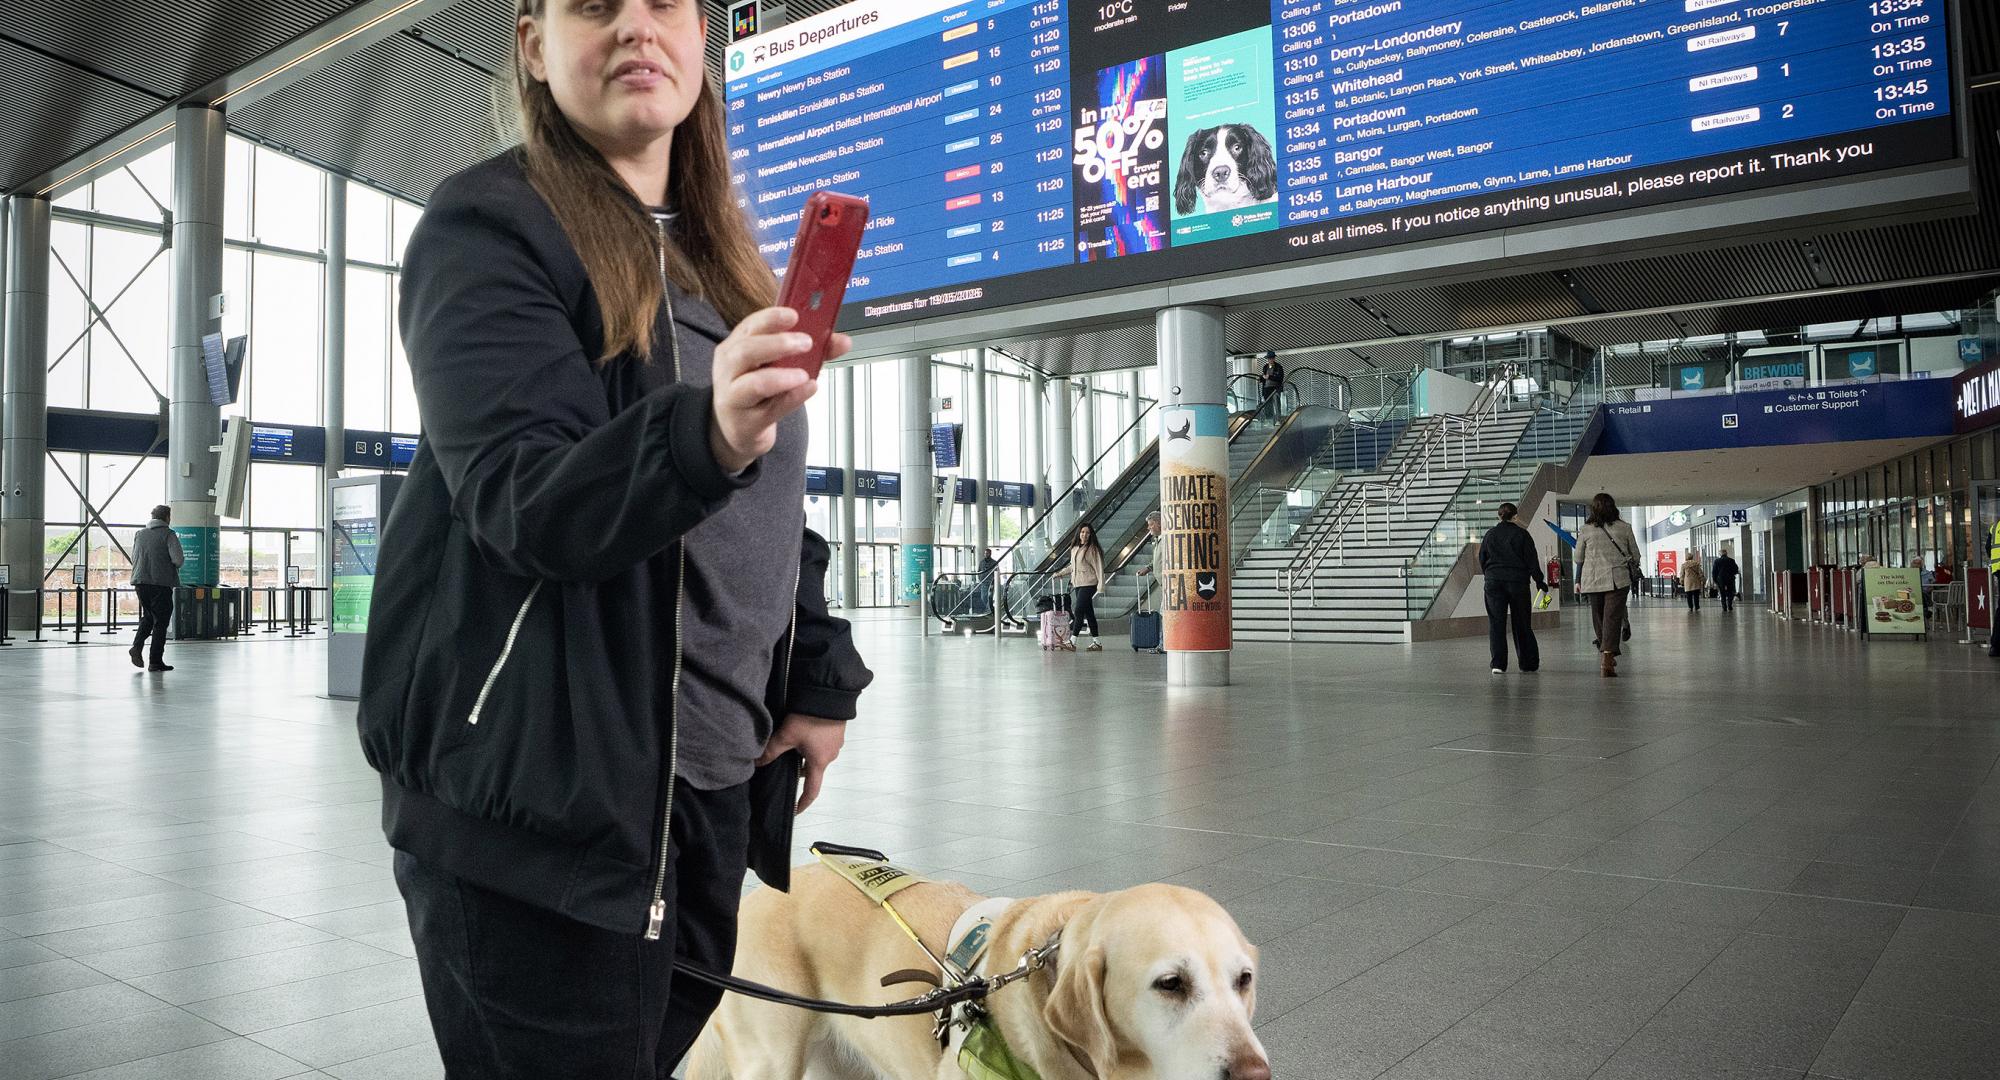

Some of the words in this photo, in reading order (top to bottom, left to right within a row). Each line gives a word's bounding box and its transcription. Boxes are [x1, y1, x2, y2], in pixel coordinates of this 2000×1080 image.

[943, 10, 968, 24] Operator
[1032, 1, 1059, 17] 11:15
[1098, 0, 1133, 21] 10°C
[1168, 2, 1188, 13] Friday
[1282, 6, 1311, 20] Calling
[1312, 4, 1322, 13] at
[1282, 22, 1316, 39] 13:06
[1330, 1, 1401, 27] Portadown
[1777, 22, 1790, 37] 7
[1869, 0, 1923, 17] 13:34
[769, 39, 795, 57] Bus
[799, 10, 880, 46] Departures
[1032, 29, 1060, 45] 11:20
[1094, 18, 1125, 33] moderate
[1124, 14, 1138, 25] rain
[1871, 22, 1892, 34] On
[1894, 14, 1930, 29] Time
[1284, 55, 1318, 72] 13:10
[1331, 22, 1462, 61] Derry~Londonderry
[1346, 53, 1404, 72] Cullybackey,
[1407, 38, 1464, 58] Ballymoney,
[1466, 26, 1517, 44] Coleraine,
[1520, 10, 1579, 31] Castlerock,
[731, 99, 745, 111] 238
[758, 89, 782, 103] Newry
[782, 82, 806, 98] Newry
[807, 76, 823, 88] Bus
[823, 66, 851, 83] Station
[988, 20, 995, 31] 5
[1033, 58, 1061, 75] 11:20
[1351, 91, 1388, 106] Botanic,
[1391, 83, 1425, 98] Lanyon
[1427, 76, 1457, 89] Place,
[1459, 70, 1482, 82] York
[1485, 62, 1518, 76] Street,
[1520, 48, 1586, 68] Whiteabbey,
[1588, 30, 1664, 54] Jordanstown,
[1667, 12, 1742, 36] Greenisland,
[1699, 80, 1709, 88] NI
[1710, 72, 1749, 85] Railways
[1780, 63, 1790, 77] 1
[1871, 36, 1926, 59] 13:35
[1873, 65, 1894, 76] On
[1897, 58, 1933, 72] Time
[732, 124, 745, 136] 261
[758, 109, 799, 128] Enniskillen
[800, 98, 839, 115] Enniskillen
[840, 91, 855, 104] Bus
[856, 82, 885, 98] Station
[988, 47, 1001, 59] 15
[1034, 88, 1062, 104] 11:20
[1286, 88, 1319, 106] 13:15
[1332, 70, 1403, 96] Whitehead
[732, 148, 750, 161] 300a
[758, 132, 806, 153] International
[806, 122, 835, 142] Airport
[836, 114, 863, 131] Belfast
[863, 102, 913, 122] International
[914, 92, 943, 109] Airport
[989, 76, 1002, 87] 10
[1082, 108, 1097, 125] in
[1100, 101, 1129, 122] my
[1701, 120, 1711, 128] NI
[1713, 112, 1751, 126] Railways
[1782, 104, 1794, 119] 2
[1874, 79, 1929, 101] 13:45
[1035, 118, 1062, 134] 11:20
[1286, 122, 1320, 140] 13:34
[1334, 106, 1406, 130] Portadown
[1357, 127, 1386, 139] Moira,
[1388, 119, 1423, 134] Lurgan,
[1426, 106, 1479, 125] Portadown
[758, 160, 798, 179] Newcastle
[798, 148, 838, 167] Newcastle
[838, 142, 855, 156] Bus
[855, 136, 884, 152] Station
[990, 104, 1002, 117] 24
[1074, 113, 1164, 165] 50%
[758, 188, 788, 204] Lisburn
[788, 180, 815, 196] Lisburn
[816, 176, 831, 189] Bus
[832, 169, 860, 186] Station
[990, 132, 1003, 145] 25
[1036, 148, 1063, 163] 11:20
[1082, 149, 1138, 184] OFF
[1288, 156, 1322, 173] 13:35
[1334, 146, 1384, 165] Bangor
[1345, 162, 1388, 176] Carnalea,
[1390, 154, 1425, 168] Bangor
[1426, 148, 1455, 160] West,
[1457, 140, 1494, 155] Bangor
[1036, 178, 1064, 193] 11:20
[1128, 172, 1160, 190] era
[1288, 190, 1323, 207] 13:45
[1336, 182, 1374, 199] Larne
[1377, 171, 1434, 191] Harbour
[1312, 230, 1325, 243] at
[1328, 226, 1344, 242] all
[1346, 220, 1388, 238] times.
[1392, 218, 1401, 231] If
[1404, 214, 1431, 232] you
[1436, 206, 1480, 224] notice
[1484, 193, 1550, 217] anything
[1554, 181, 1623, 205] unusual,
[1628, 171, 1684, 197] please
[1690, 162, 1744, 184] report
[1749, 159, 1766, 174] it.
[1770, 148, 1832, 170] Thank
[1836, 142, 1873, 164] you
[1356, 194, 1403, 210] Ballycarry,
[1406, 181, 1481, 200] Magheramorne,
[1484, 174, 1517, 188] Glynn,
[1520, 170, 1552, 182] Larne,
[1554, 163, 1585, 176] Larne
[1587, 154, 1633, 170] Harbour
[758, 210, 799, 231] Sydenham
[990, 162, 1003, 174] 20
[758, 239, 789, 255] Finaghy
[876, 215, 895, 230] Ride
[992, 191, 1004, 203] 13
[1037, 208, 1064, 223] 11:25
[857, 247, 873, 259] Bus
[874, 242, 904, 256] Station
[992, 220, 1005, 233] 22
[1744, 362, 1804, 380] BREWDOG
[1776, 402, 1819, 413] Customer
[1822, 400, 1860, 411] Support
[1828, 390, 1859, 400] Toilets
[1963, 376, 1980, 418] PRET
[1982, 376, 1988, 412] A
[1618, 406, 1641, 415] Retail
[374, 442, 383, 456] 8
[866, 478, 876, 489] 12
[994, 488, 1003, 497] 14
[859, 869, 880, 879] I'm
